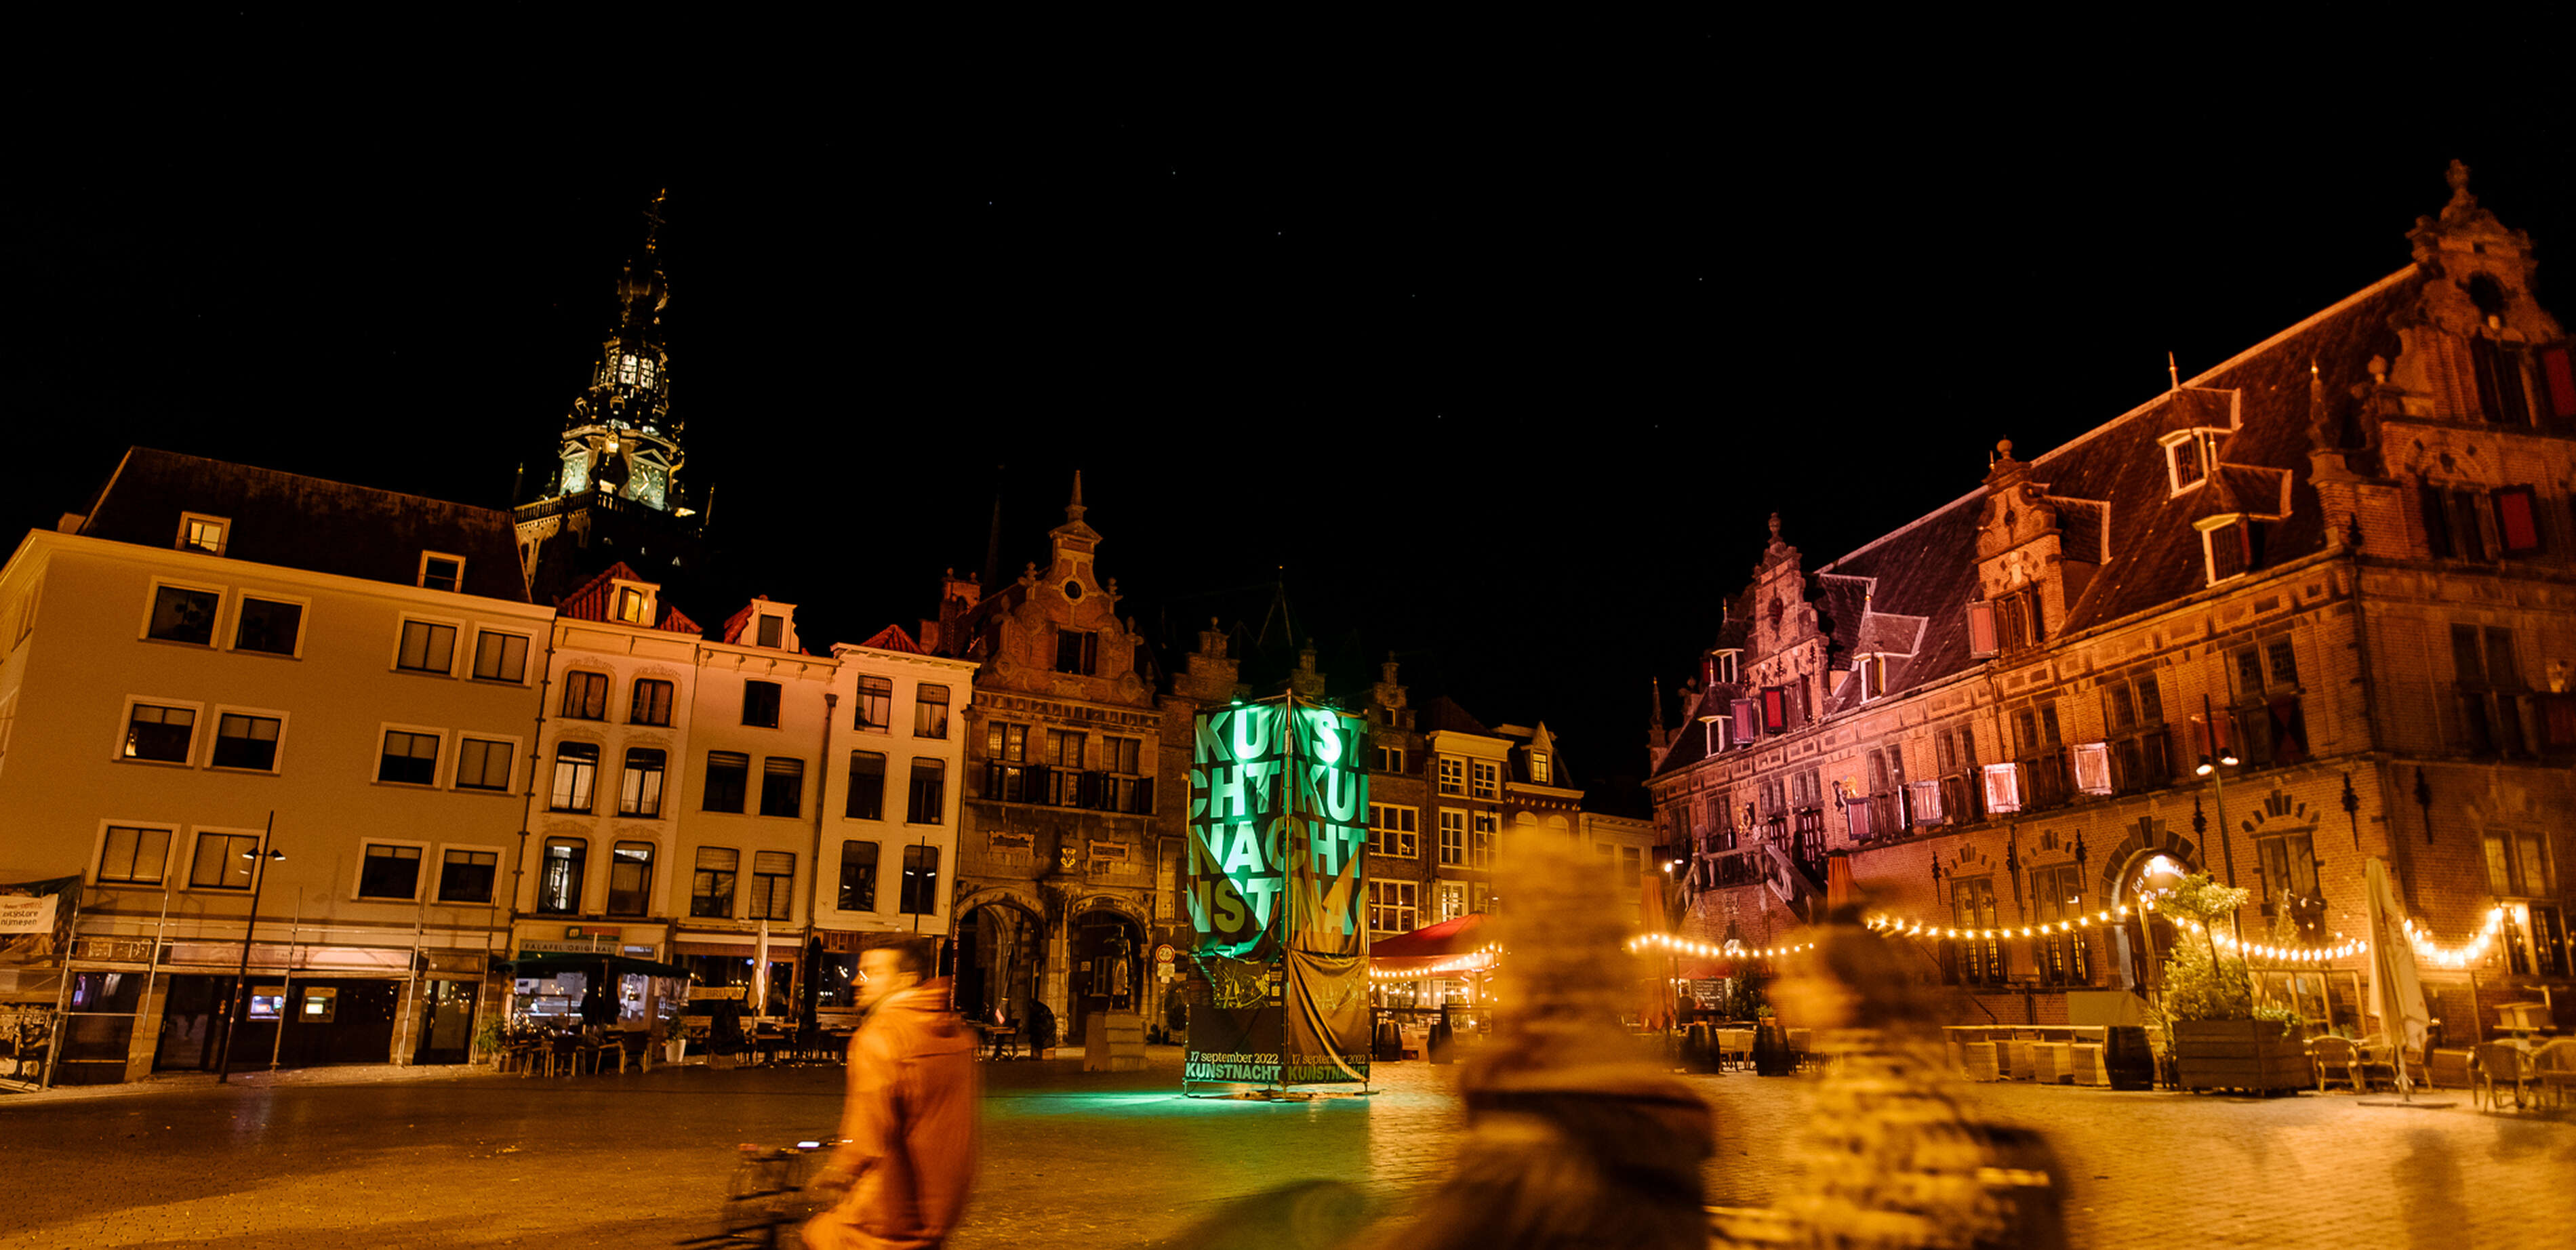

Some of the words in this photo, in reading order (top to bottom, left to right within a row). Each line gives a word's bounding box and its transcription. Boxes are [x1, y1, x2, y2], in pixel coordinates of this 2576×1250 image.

[525, 943, 563, 951] FALAFEL
[1190, 1051, 1200, 1062] 17
[1201, 1051, 1253, 1064] september
[1254, 1053, 1279, 1065] 2022
[1292, 1053, 1302, 1065] 17
[1302, 1054, 1346, 1066] septemr
[1348, 1054, 1366, 1065] 2022
[1185, 1062, 1282, 1081] KUNSTNACHT
[1288, 1065, 1368, 1081] KUNSTNAT
